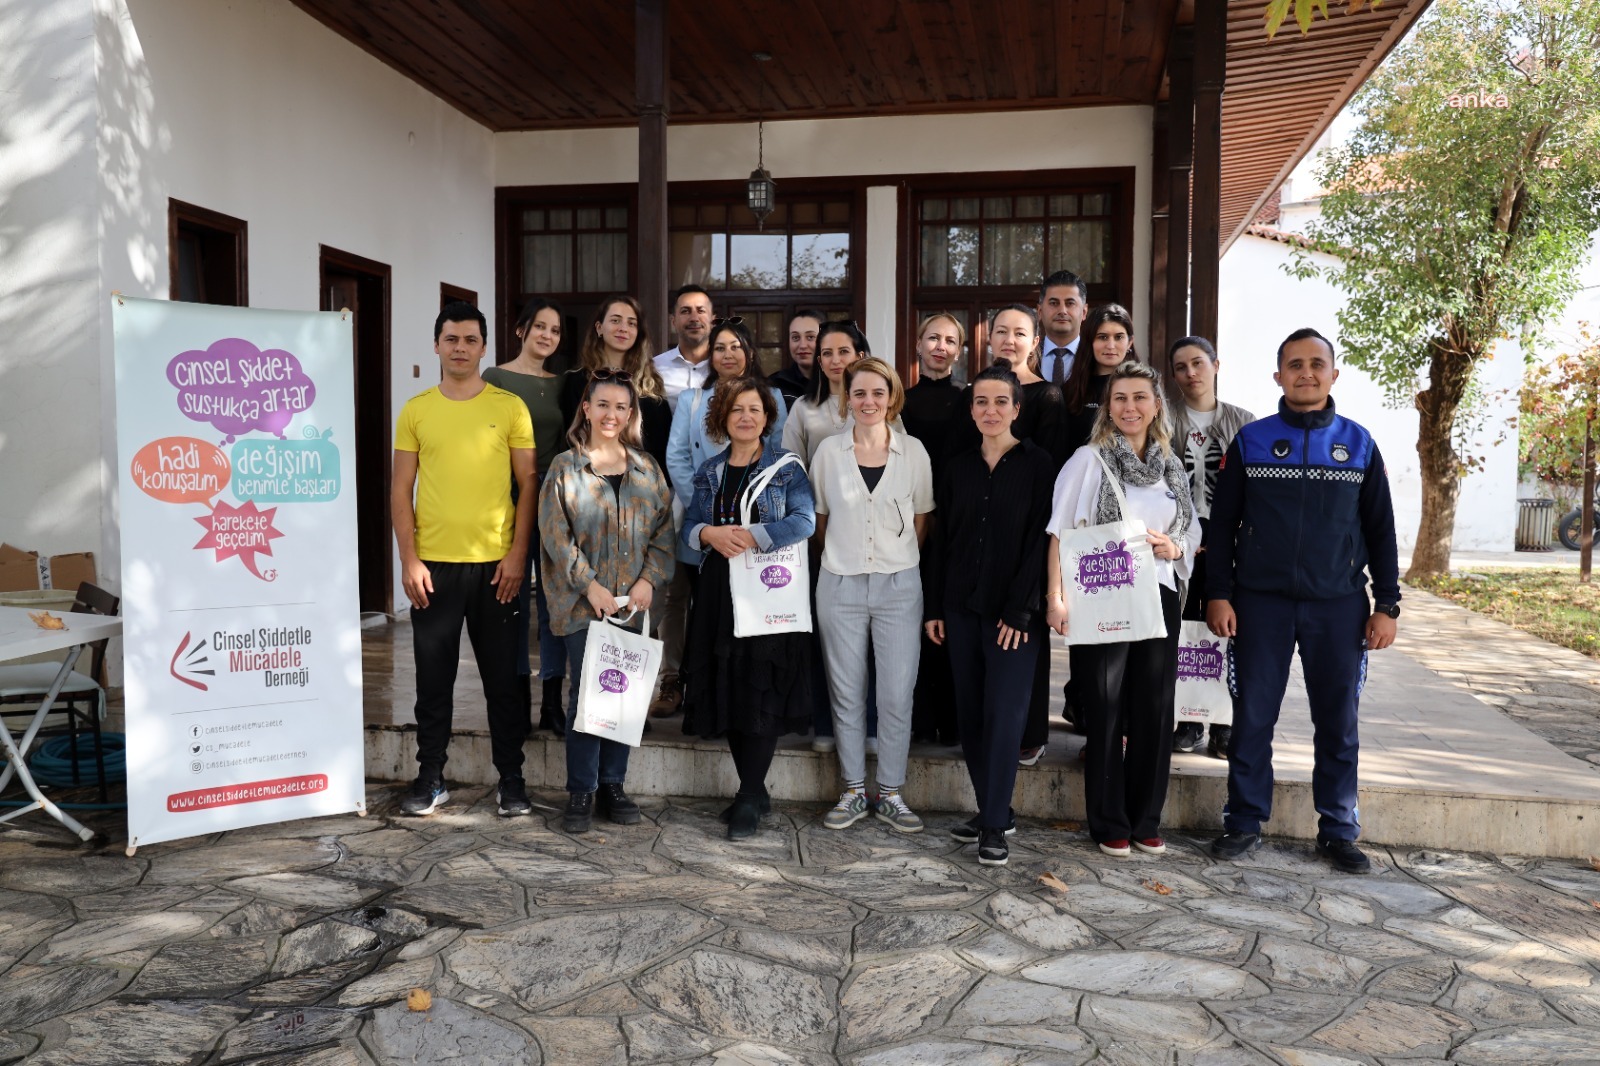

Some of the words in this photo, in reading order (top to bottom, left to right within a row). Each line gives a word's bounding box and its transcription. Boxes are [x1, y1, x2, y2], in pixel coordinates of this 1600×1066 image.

[174, 358, 236, 386] cinsel
[238, 356, 294, 388] şiddet
[184, 393, 260, 423] sustukça
[260, 385, 309, 412] artar
[157, 443, 200, 471] hadi
[237, 445, 322, 480] değişim
[238, 477, 289, 495] benimle
[294, 477, 336, 498] başlar!
[212, 515, 268, 531] harekete
[216, 530, 267, 550] geçelim.
[1085, 556, 1127, 573] değişim
[213, 628, 255, 651] Cinsel
[258, 626, 312, 652] Şiddetle
[229, 646, 302, 672] Mücadele
[1177, 650, 1216, 666] değişim
[265, 667, 309, 687] Derneği
[170, 778, 324, 809] www.cinselsiddetlemucadele.org
